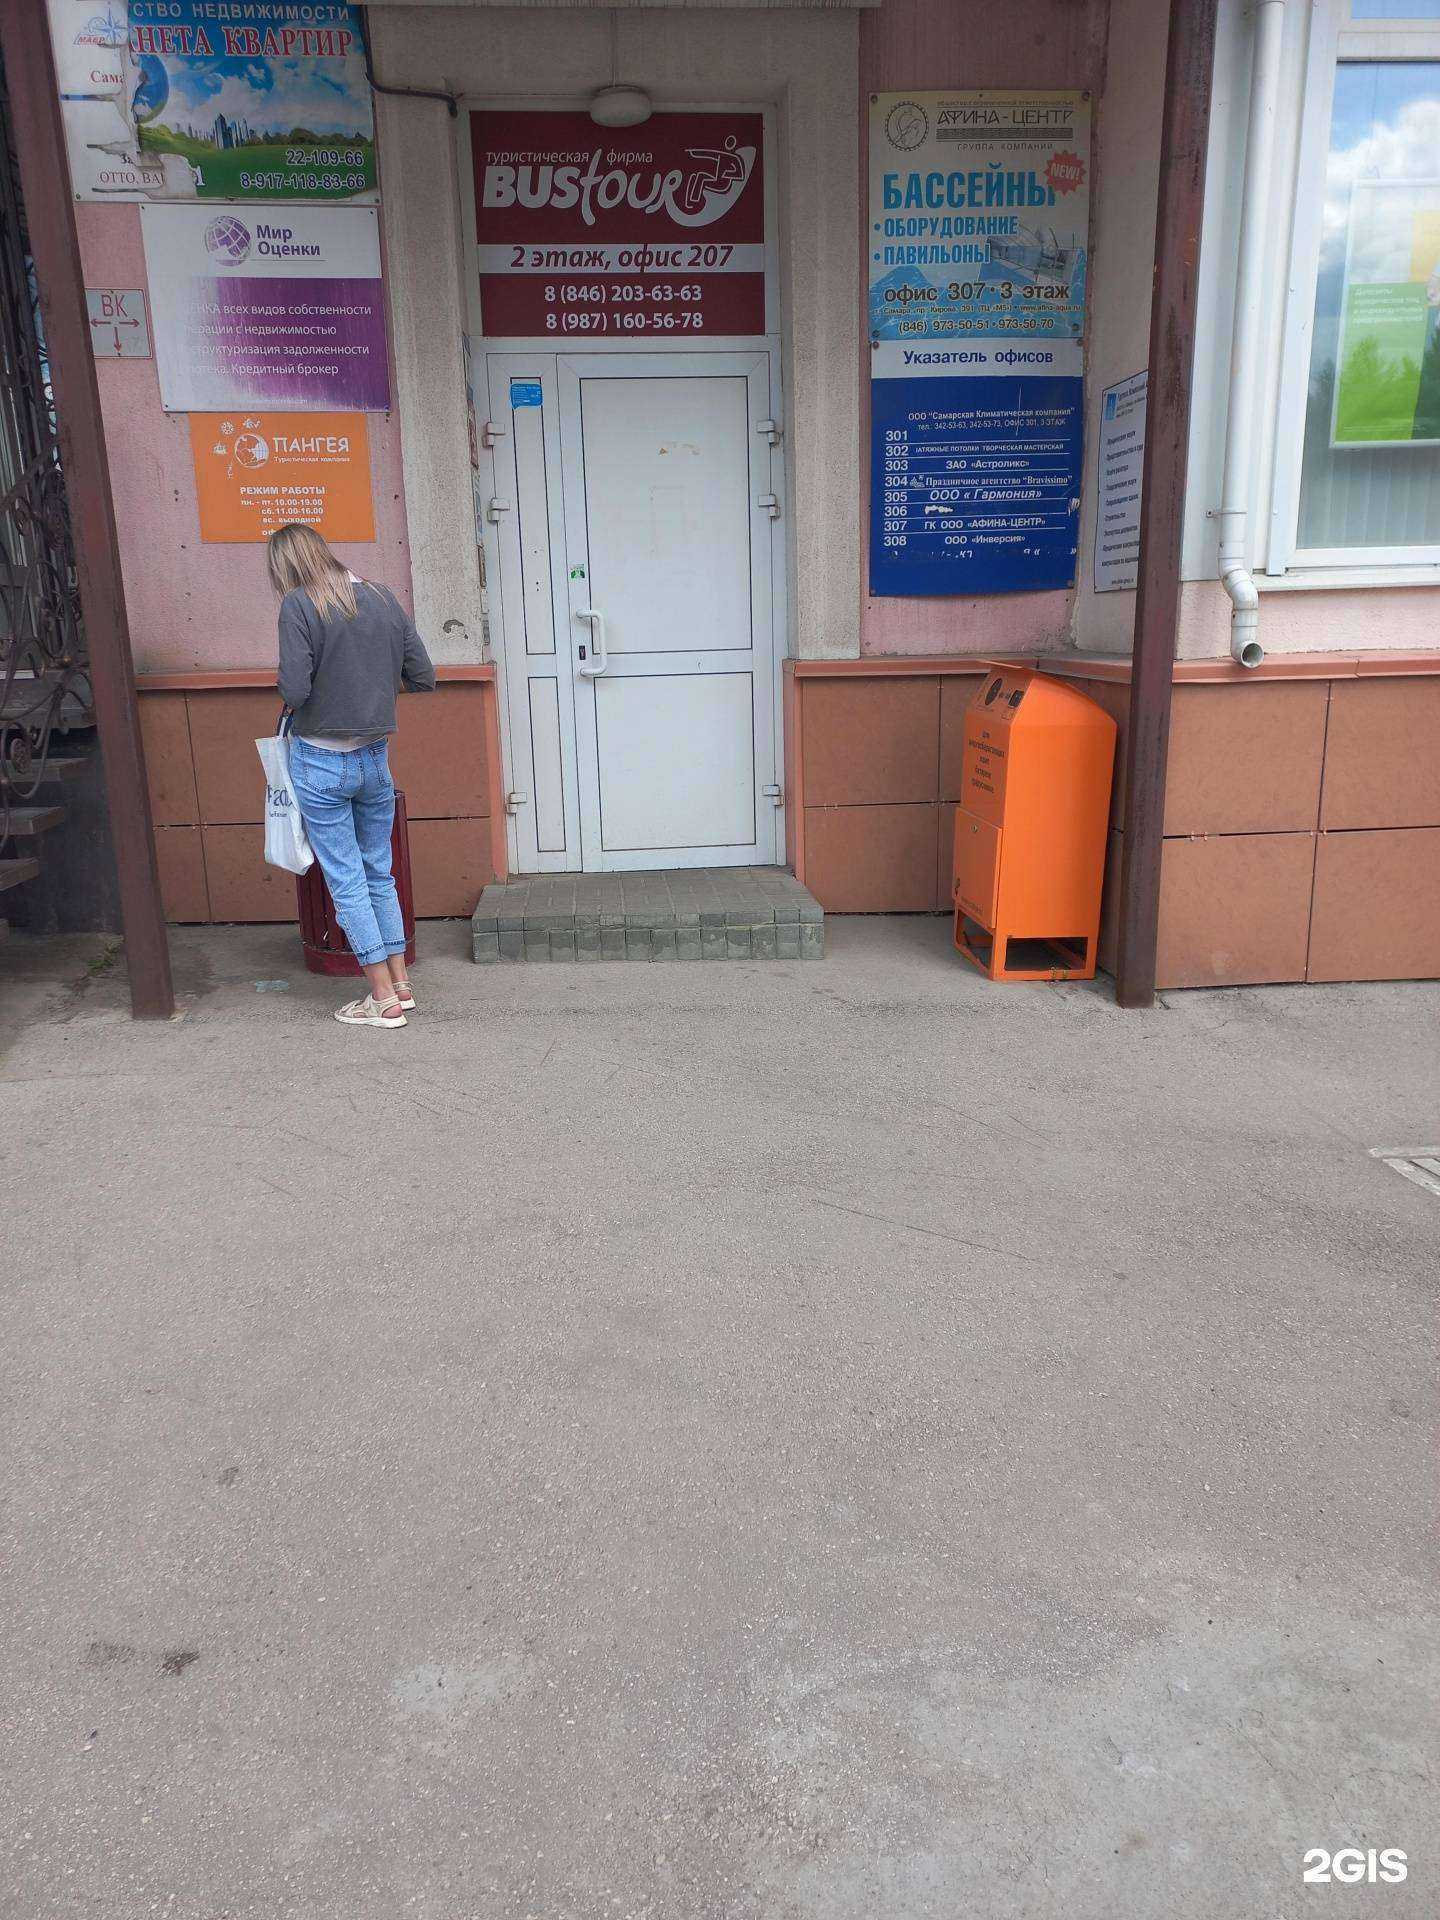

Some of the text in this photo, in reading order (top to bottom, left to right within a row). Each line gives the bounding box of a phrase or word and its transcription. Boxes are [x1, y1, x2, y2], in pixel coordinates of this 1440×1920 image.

[128, 2, 349, 20] СТВО НЕДВИЖИМОСТИ
[221, 26, 352, 57] КВАРТИР
[957, 143, 994, 151] ГРУППА
[287, 150, 363, 166] 22-109-66
[486, 149, 653, 165] туристическая фирма
[1050, 163, 1080, 180] NEW!
[240, 173, 365, 189] 8-917-118-83-66
[883, 162, 1056, 209] БАССЕЙНЫ
[256, 224, 293, 240] Мир
[884, 216, 1018, 238] ОБОРУДОВАНИЕ
[258, 242, 321, 258] Оценки
[884, 245, 990, 265] ПАВИЛЬОНЫ
[510, 244, 733, 273] 2 этаж, офис 207
[544, 285, 702, 304] 8 (846) 203-63-63
[884, 282, 1069, 304] офис 307 3 этаж
[101, 295, 128, 317] ВК
[223, 305, 249, 314] всех
[251, 305, 286, 316] видов
[288, 303, 372, 315] собственности
[546, 313, 704, 332] 8 (987) 160-56-78
[899, 319, 1054, 334] (846) 973-50-51 973-50-70
[244, 326, 337, 336] недвижимостью
[282, 345, 370, 356] задолженности
[903, 350, 1053, 365] Указатель офисов
[231, 362, 295, 376] Кредитный
[297, 362, 339, 376] брокер
[908, 412, 927, 420] ООО
[976, 407, 1034, 418] Климатическая
[1004, 418, 1025, 427] ОФИС
[886, 430, 908, 441] 301
[272, 437, 349, 453] ПАНГЕЯ
[886, 445, 909, 456] 302
[885, 460, 1030, 471] 303 ЗАО «Астроликс»
[885, 475, 908, 487] 304
[925, 477, 979, 487] Праздничное
[240, 487, 325, 495] РЕЖИМ РАБОТЫ
[884, 491, 908, 502] 305
[930, 490, 960, 501] ООО
[884, 505, 908, 517] 306
[884, 518, 1046, 531] 307 ГК ООО «АФИНА-ЦЕНТР»
[883, 534, 1026, 546] 308 ООО «Инверсия»
